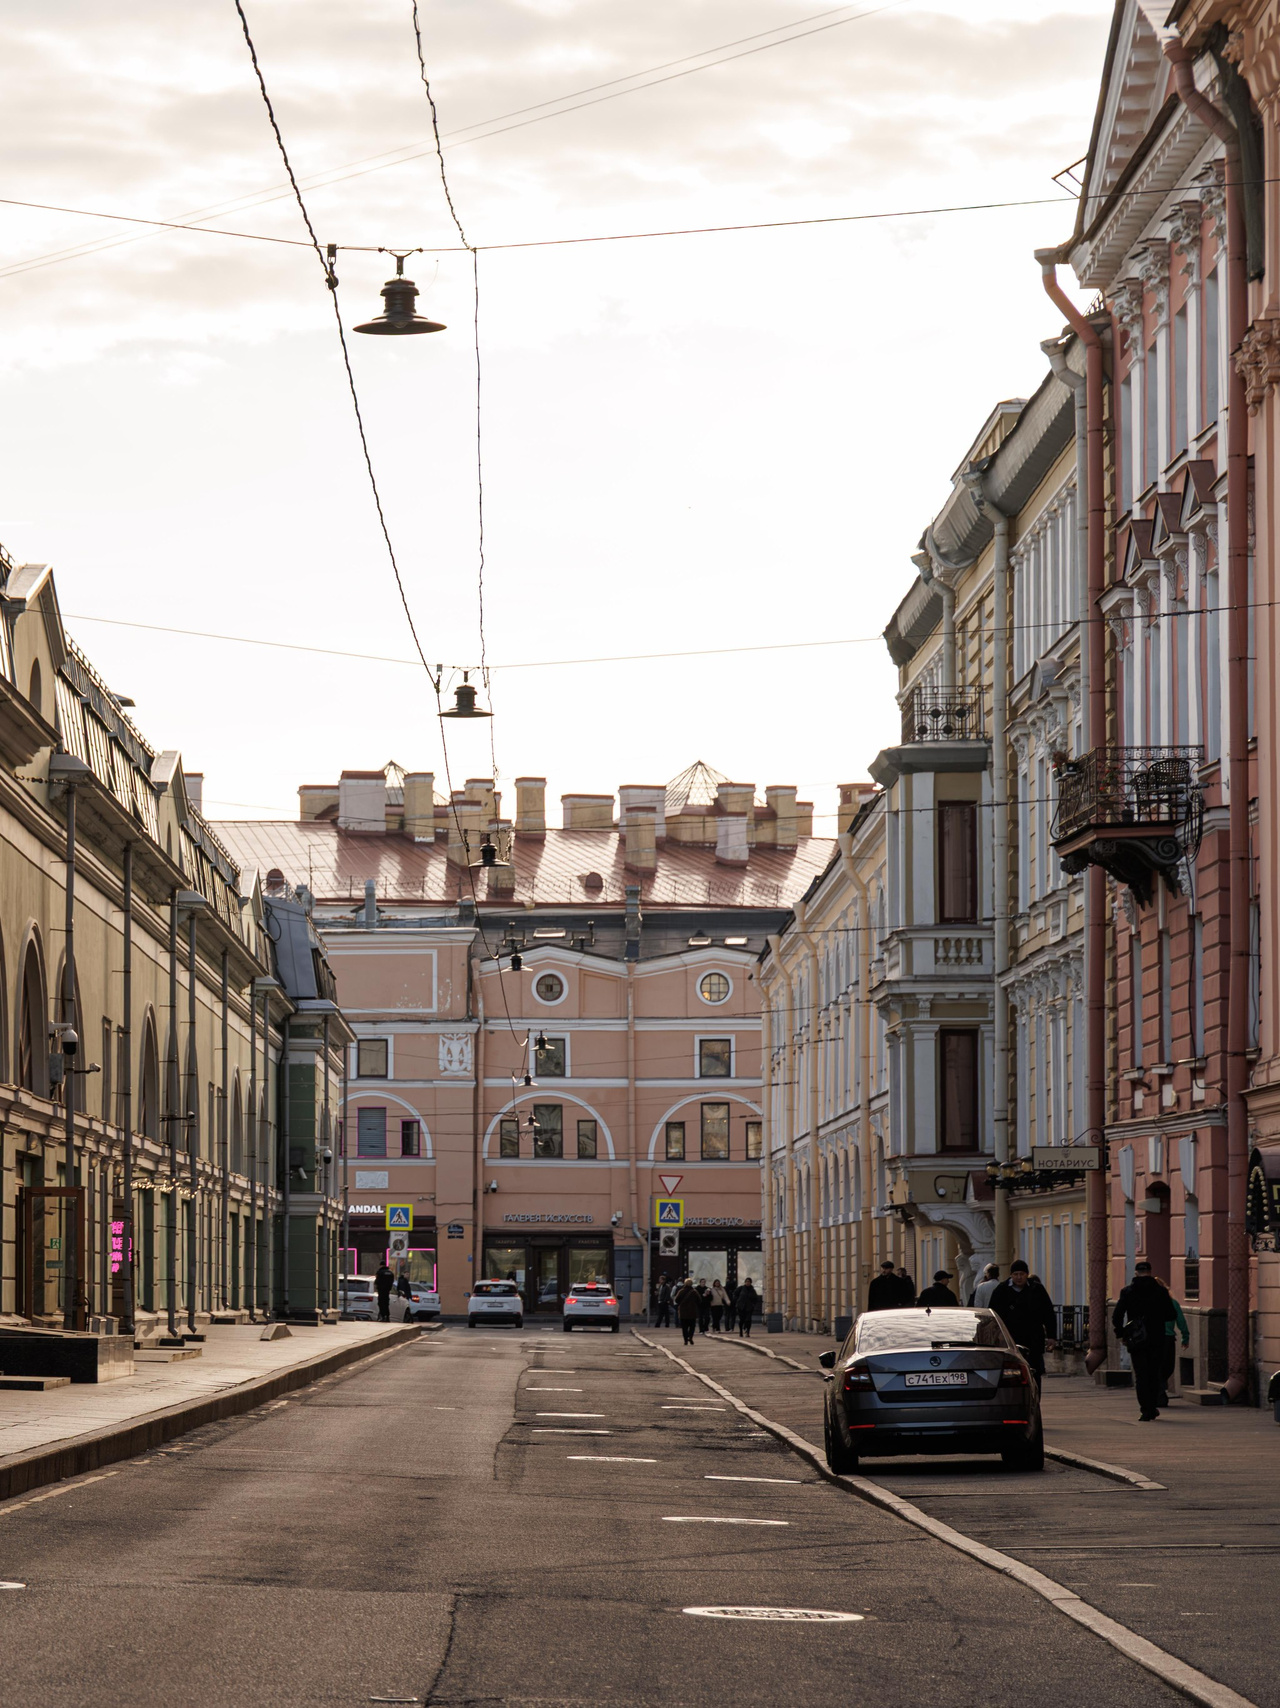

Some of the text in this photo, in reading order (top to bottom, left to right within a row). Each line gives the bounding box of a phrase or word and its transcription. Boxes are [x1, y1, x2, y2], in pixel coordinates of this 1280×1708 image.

[1038, 1159, 1095, 1168] НОТАРИУС
[348, 1205, 384, 1214] ANDAL
[503, 1213, 594, 1223] ГАЛЕРЕЯ ИСКУССТВ
[907, 1373, 965, 1385] С741ЕХ 198
